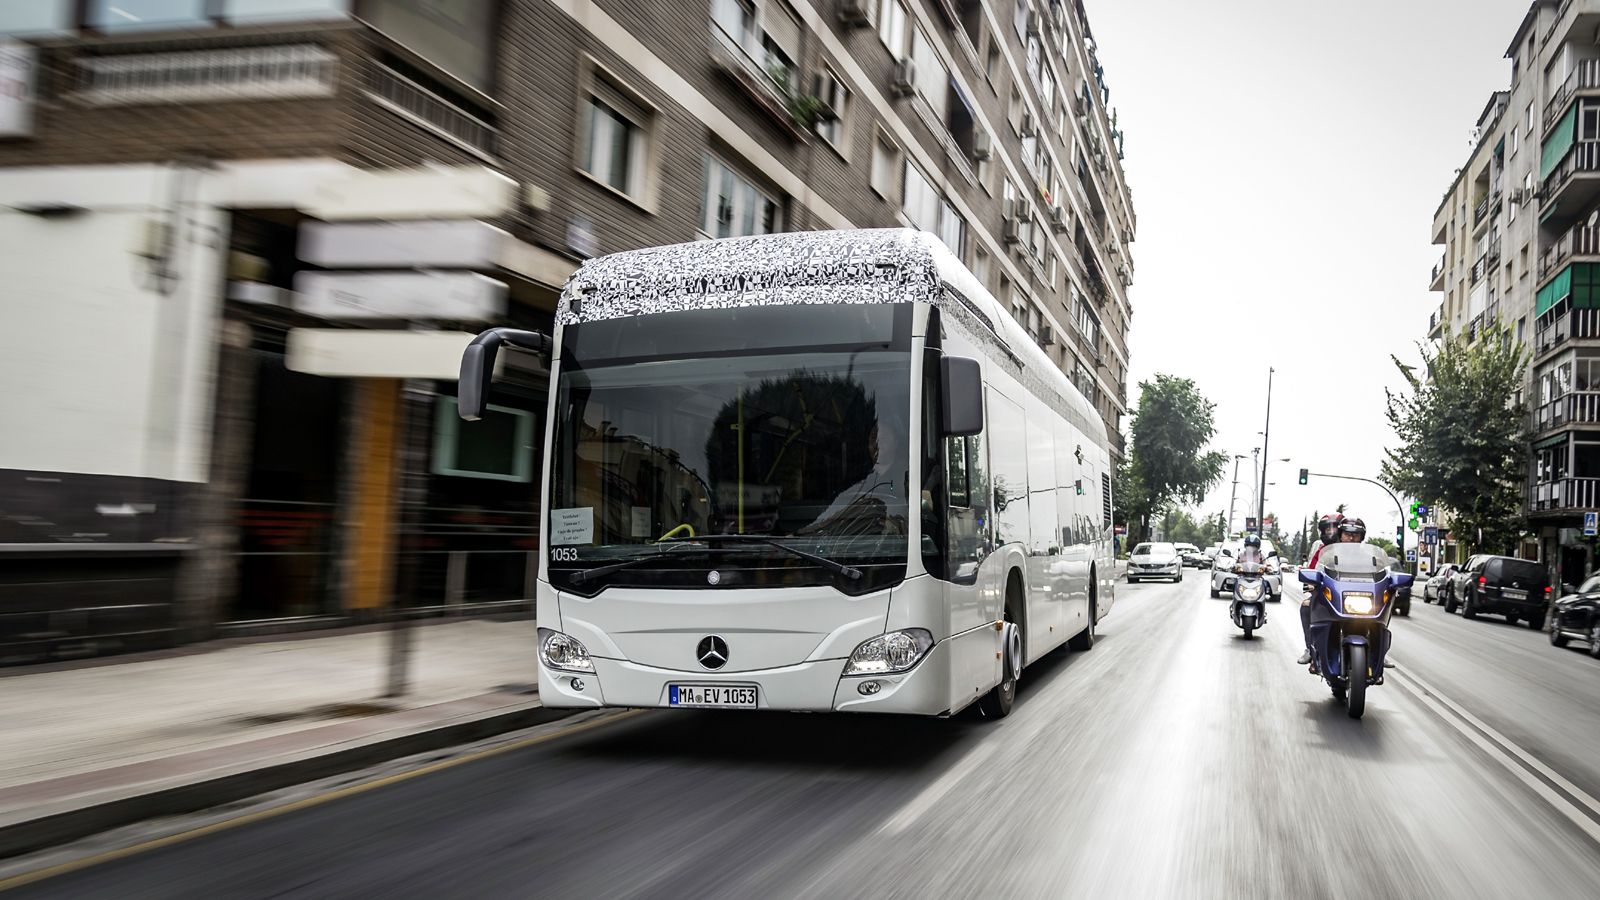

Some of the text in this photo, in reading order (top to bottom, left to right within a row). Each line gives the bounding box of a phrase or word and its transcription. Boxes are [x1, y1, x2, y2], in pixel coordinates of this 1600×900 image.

[551, 548, 577, 561] 1053
[679, 688, 755, 704] MA EV 1053
